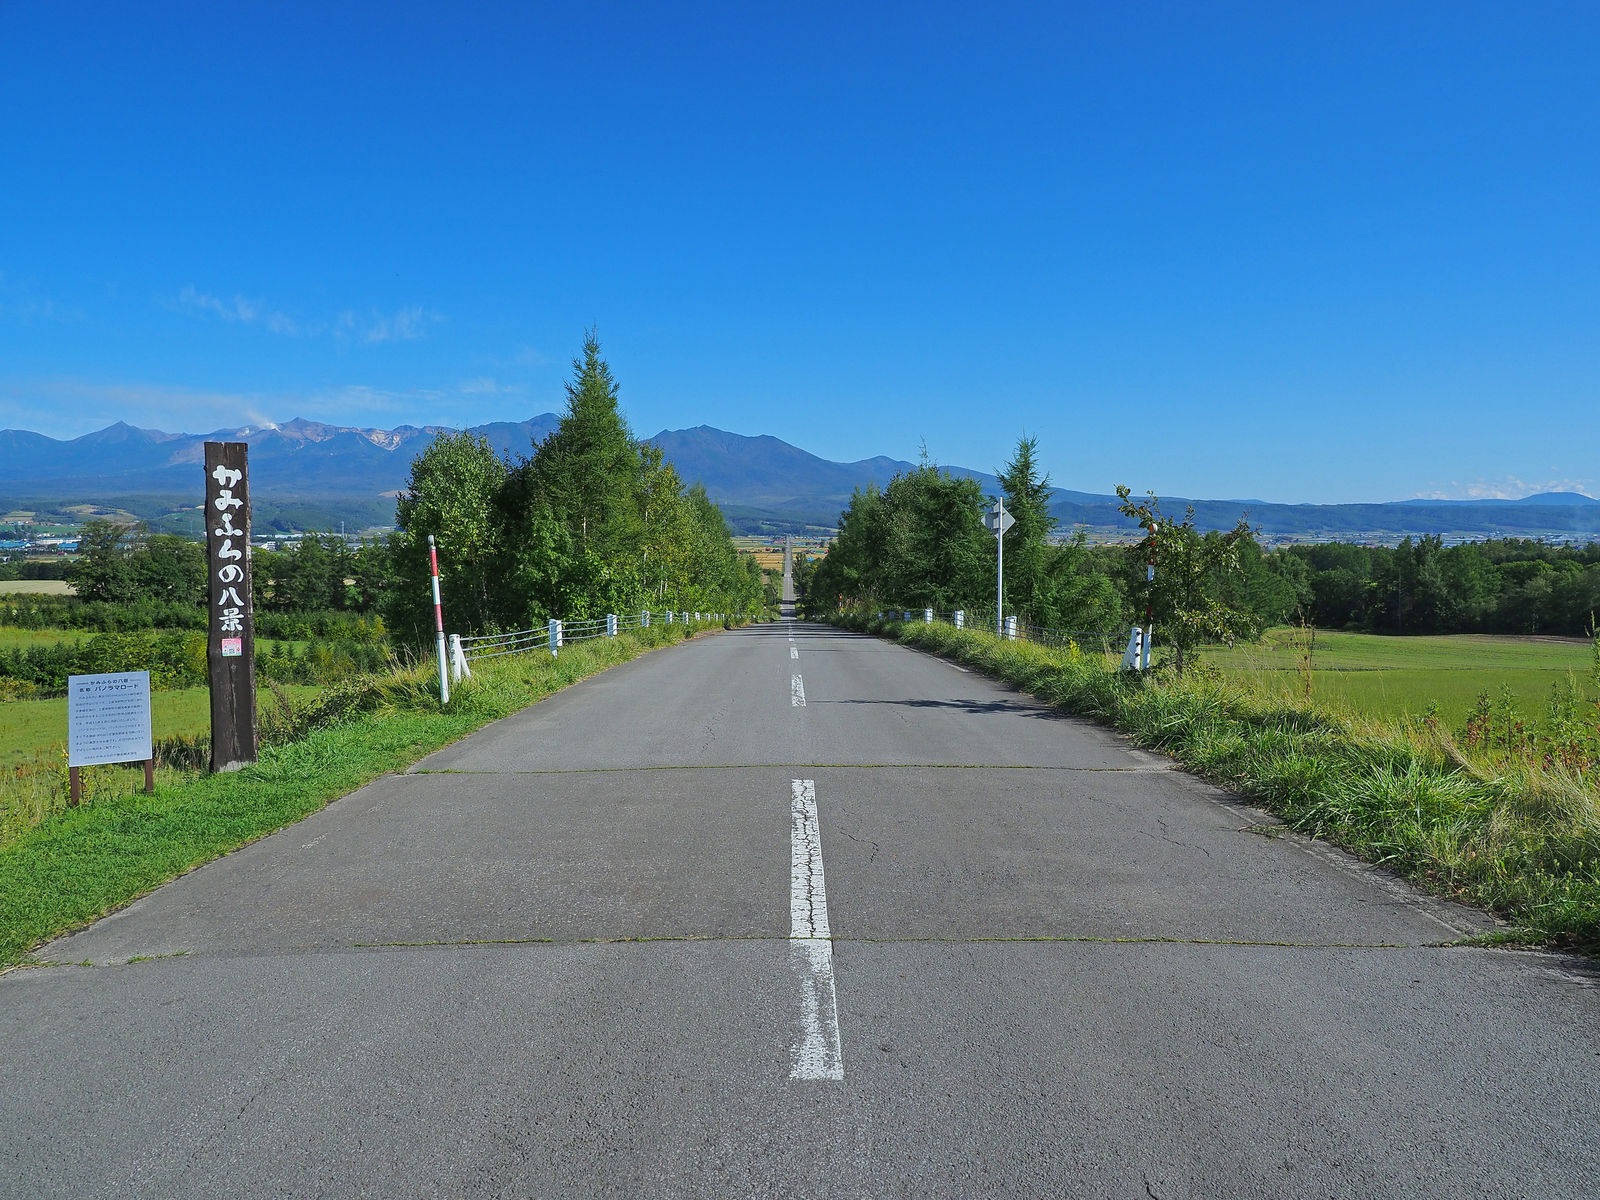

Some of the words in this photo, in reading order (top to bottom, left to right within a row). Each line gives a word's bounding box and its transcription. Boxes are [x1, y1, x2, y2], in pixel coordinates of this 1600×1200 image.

[212, 464, 245, 631] かみふらの八景
